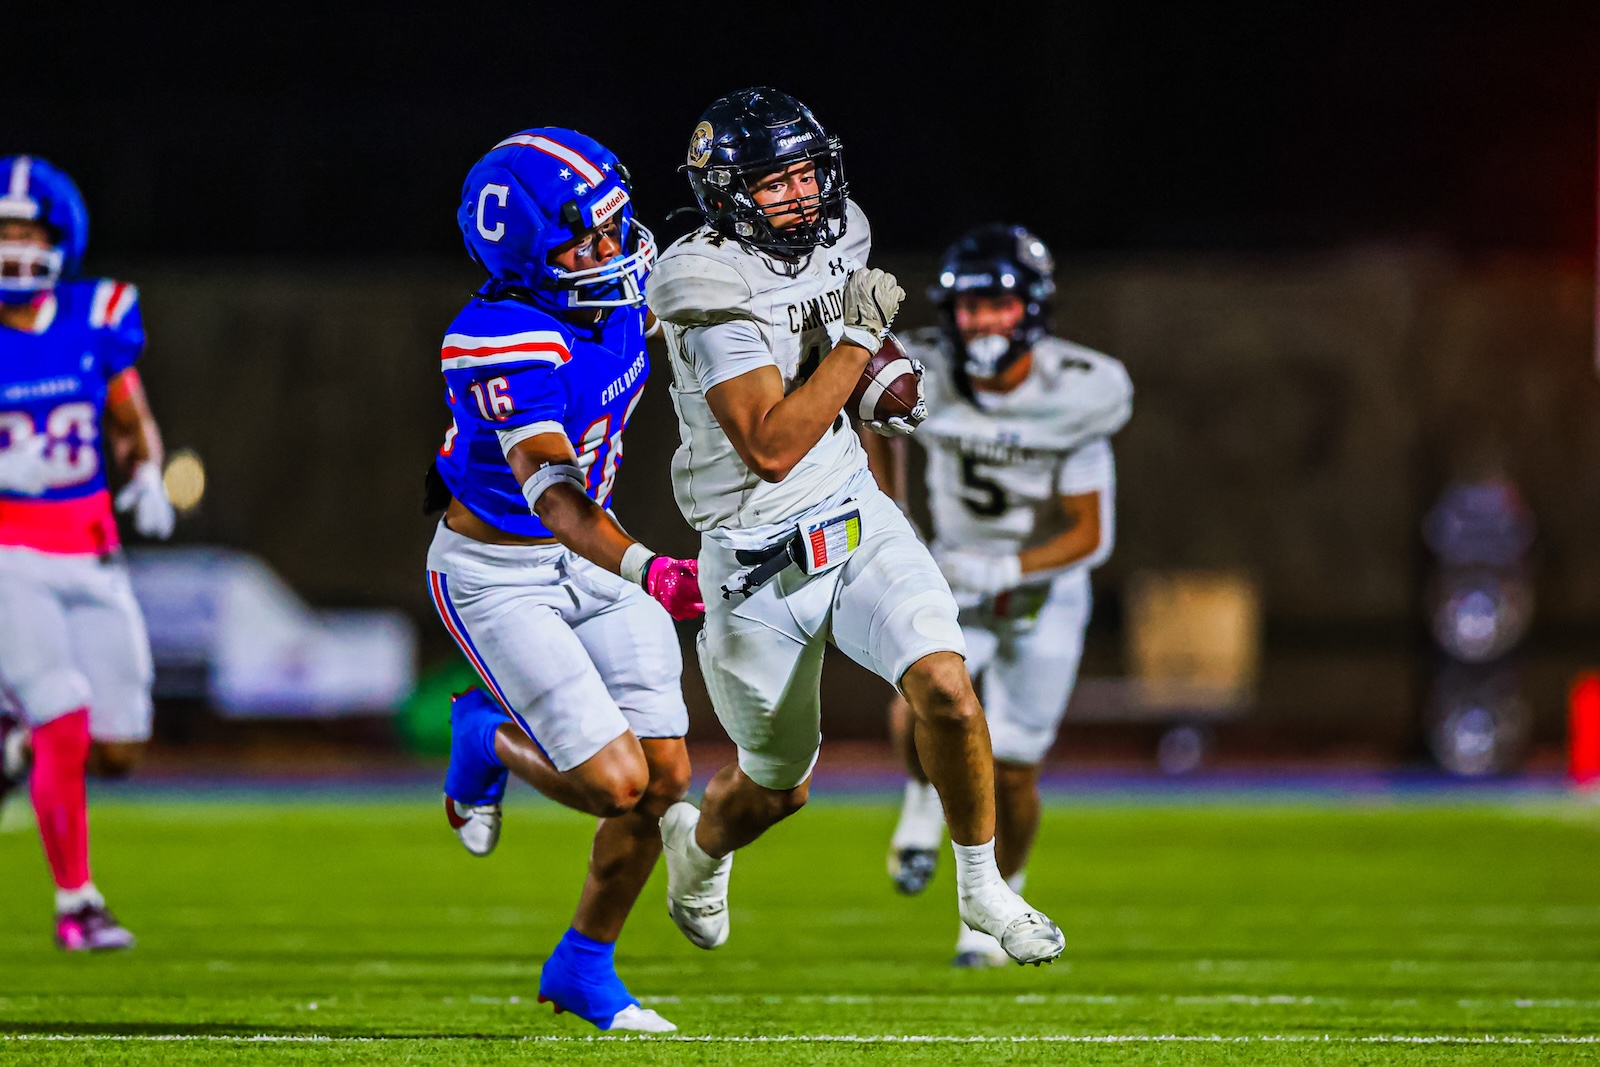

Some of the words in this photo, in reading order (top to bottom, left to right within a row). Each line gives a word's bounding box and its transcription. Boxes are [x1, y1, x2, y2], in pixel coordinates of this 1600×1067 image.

[476, 183, 509, 242] C
[595, 191, 625, 219] Riddell
[469, 376, 515, 422] 16
[601, 351, 645, 406] CHILDRESS
[959, 449, 1008, 520] 5
